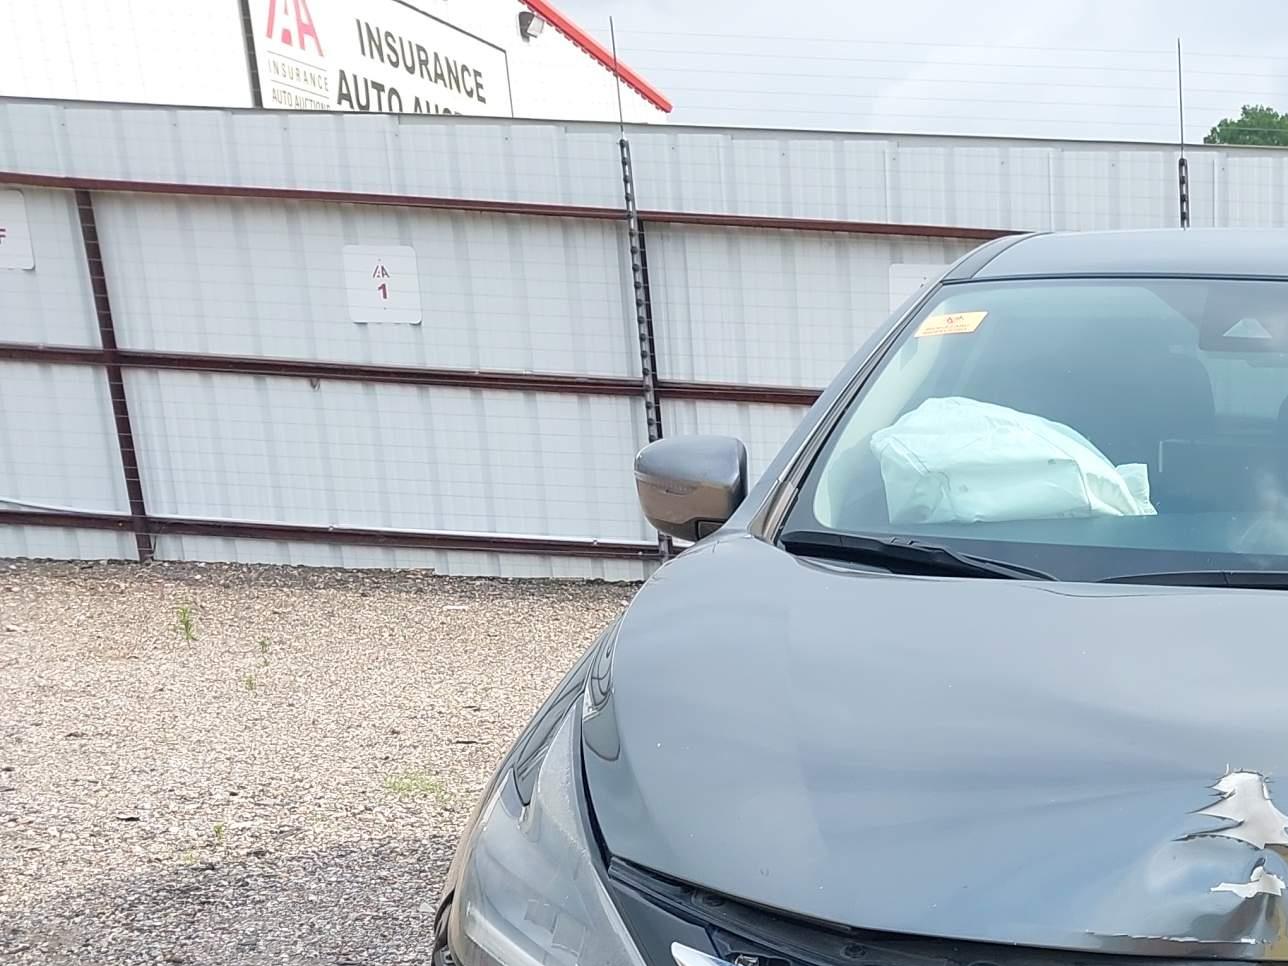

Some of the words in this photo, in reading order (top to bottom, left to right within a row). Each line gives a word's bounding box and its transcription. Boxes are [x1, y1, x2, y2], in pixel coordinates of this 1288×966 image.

[267, 58, 329, 92] INSURANCE
[355, 18, 486, 104] INSURANCE
[337, 69, 403, 112] AUTO
[377, 282, 387, 299] 1
